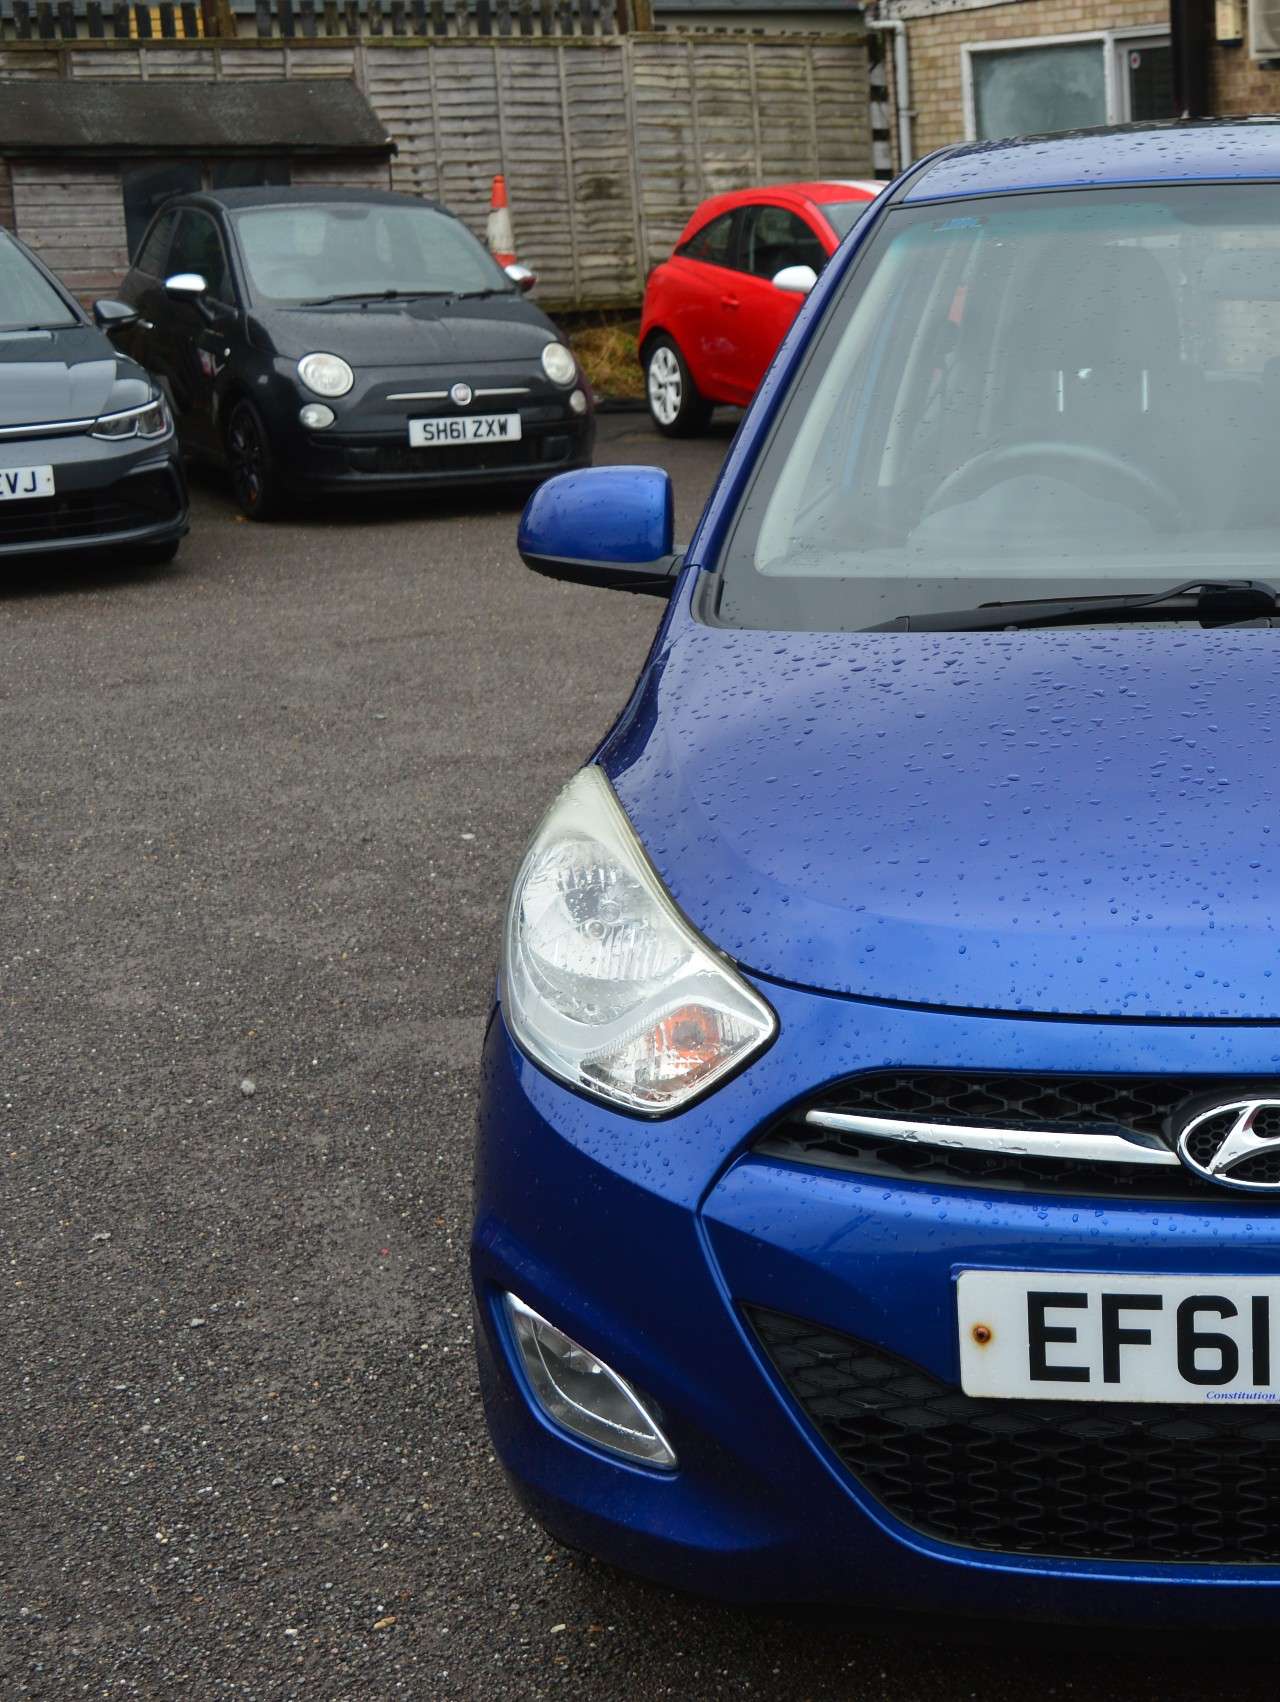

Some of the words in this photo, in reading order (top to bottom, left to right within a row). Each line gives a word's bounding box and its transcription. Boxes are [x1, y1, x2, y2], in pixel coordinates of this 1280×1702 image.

[423, 421, 466, 441] SH61
[473, 418, 508, 438] ZXW
[0, 471, 37, 494] VJ
[1027, 1290, 1271, 1386] EF61
[1206, 1391, 1276, 1400] Constitution
